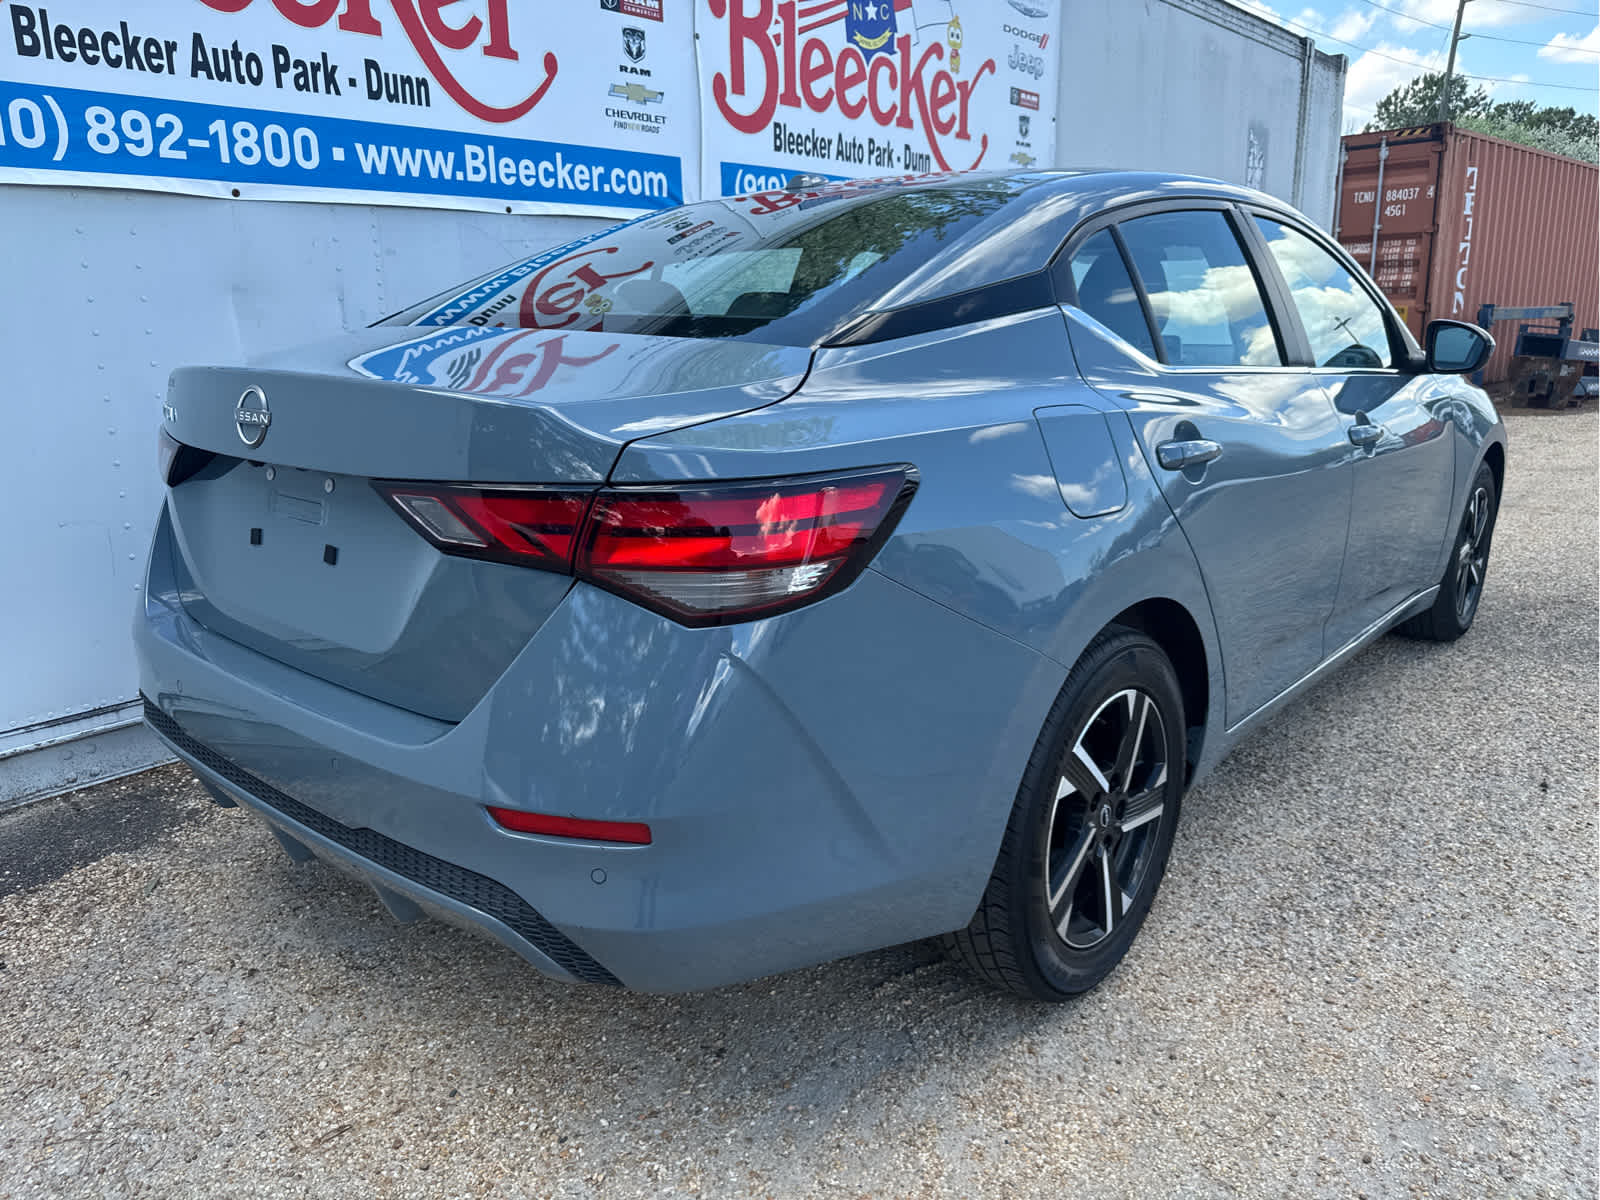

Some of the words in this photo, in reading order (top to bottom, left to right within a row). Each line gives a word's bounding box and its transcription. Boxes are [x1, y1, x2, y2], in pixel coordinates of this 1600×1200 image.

[1003, 24, 1043, 44] DODGE
[10, 4, 177, 75] Bleecker
[190, 32, 263, 86] Auto
[272, 44, 341, 96] Park
[364, 58, 431, 107] Dunn
[1008, 44, 1043, 80] Jeep
[619, 64, 651, 77] RAM
[713, 0, 995, 172] Bleecker
[605, 107, 666, 125] CHEVROLET
[84, 105, 320, 170] 892-1800
[354, 142, 669, 198] www.Bleecker.com
[773, 121, 832, 160] Bleecker
[836, 132, 864, 165] Auto
[868, 138, 894, 168] Park
[904, 144, 931, 174] Dunn
[735, 169, 788, 195] (910)
[1354, 192, 1375, 203] TCNU
[1386, 188, 1419, 202] 884037
[1385, 204, 1406, 217] 45G1
